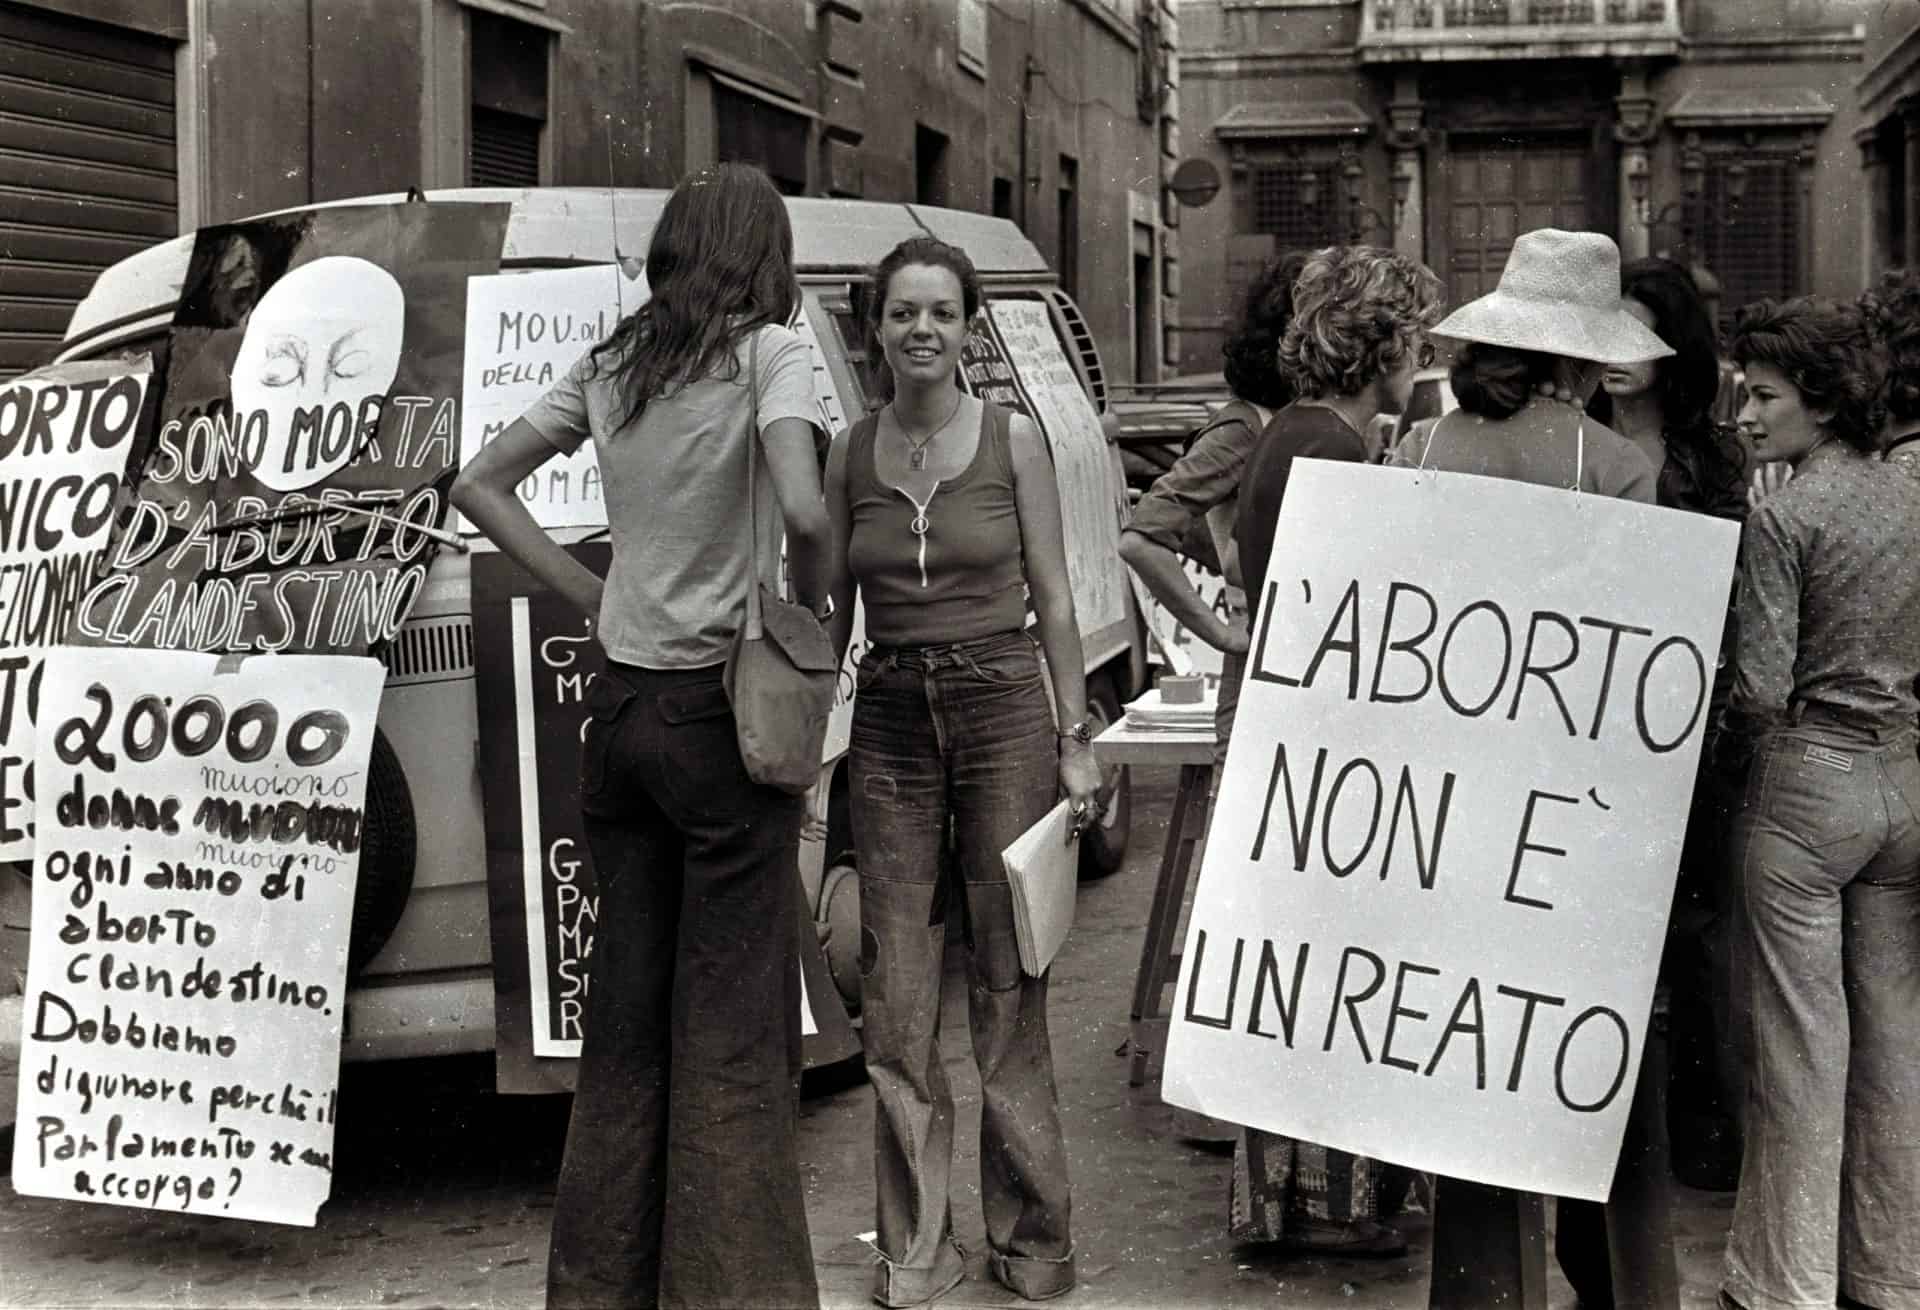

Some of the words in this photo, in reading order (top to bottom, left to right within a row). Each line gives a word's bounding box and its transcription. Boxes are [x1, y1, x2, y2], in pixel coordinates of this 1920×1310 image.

[482, 361, 553, 388] DELLA
[148, 408, 270, 485] SONO
[281, 393, 457, 475] MORTA
[111, 488, 440, 573] D'ABORTO
[77, 564, 427, 651] CLANDESTINO
[1250, 579, 1708, 753] L'ABORTO
[56, 773, 181, 836] donne
[1250, 743, 1456, 890] NON
[46, 844, 132, 909] ogni
[144, 861, 243, 896] anno
[260, 853, 310, 902] di
[31, 990, 237, 1058] Dobbiamo
[1184, 930, 1311, 1050] UN
[1322, 946, 1630, 1114] REATO
